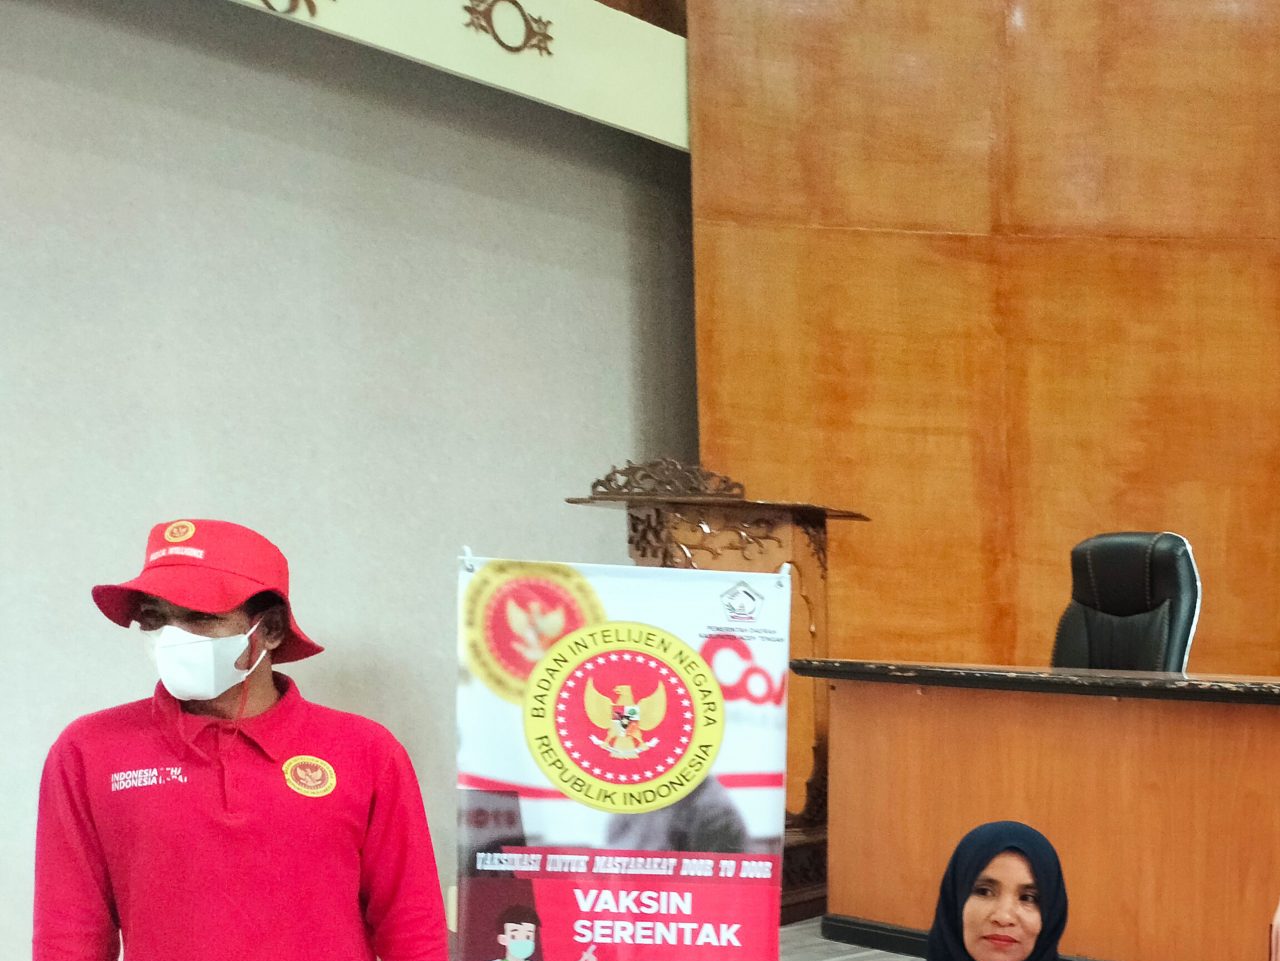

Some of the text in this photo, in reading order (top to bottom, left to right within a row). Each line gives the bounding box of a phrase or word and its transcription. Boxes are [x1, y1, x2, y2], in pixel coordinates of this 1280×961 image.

[531, 653, 569, 719] BADAN
[568, 628, 674, 656] INTELIJEN
[673, 650, 718, 728] NEGARA
[111, 767, 158, 782] INDONESIA
[535, 735, 714, 806] REPUBLIK INDONESIA
[111, 776, 158, 792] INDONESIA
[573, 888, 693, 914] VAKSIN
[573, 920, 742, 947] SERENTAK
